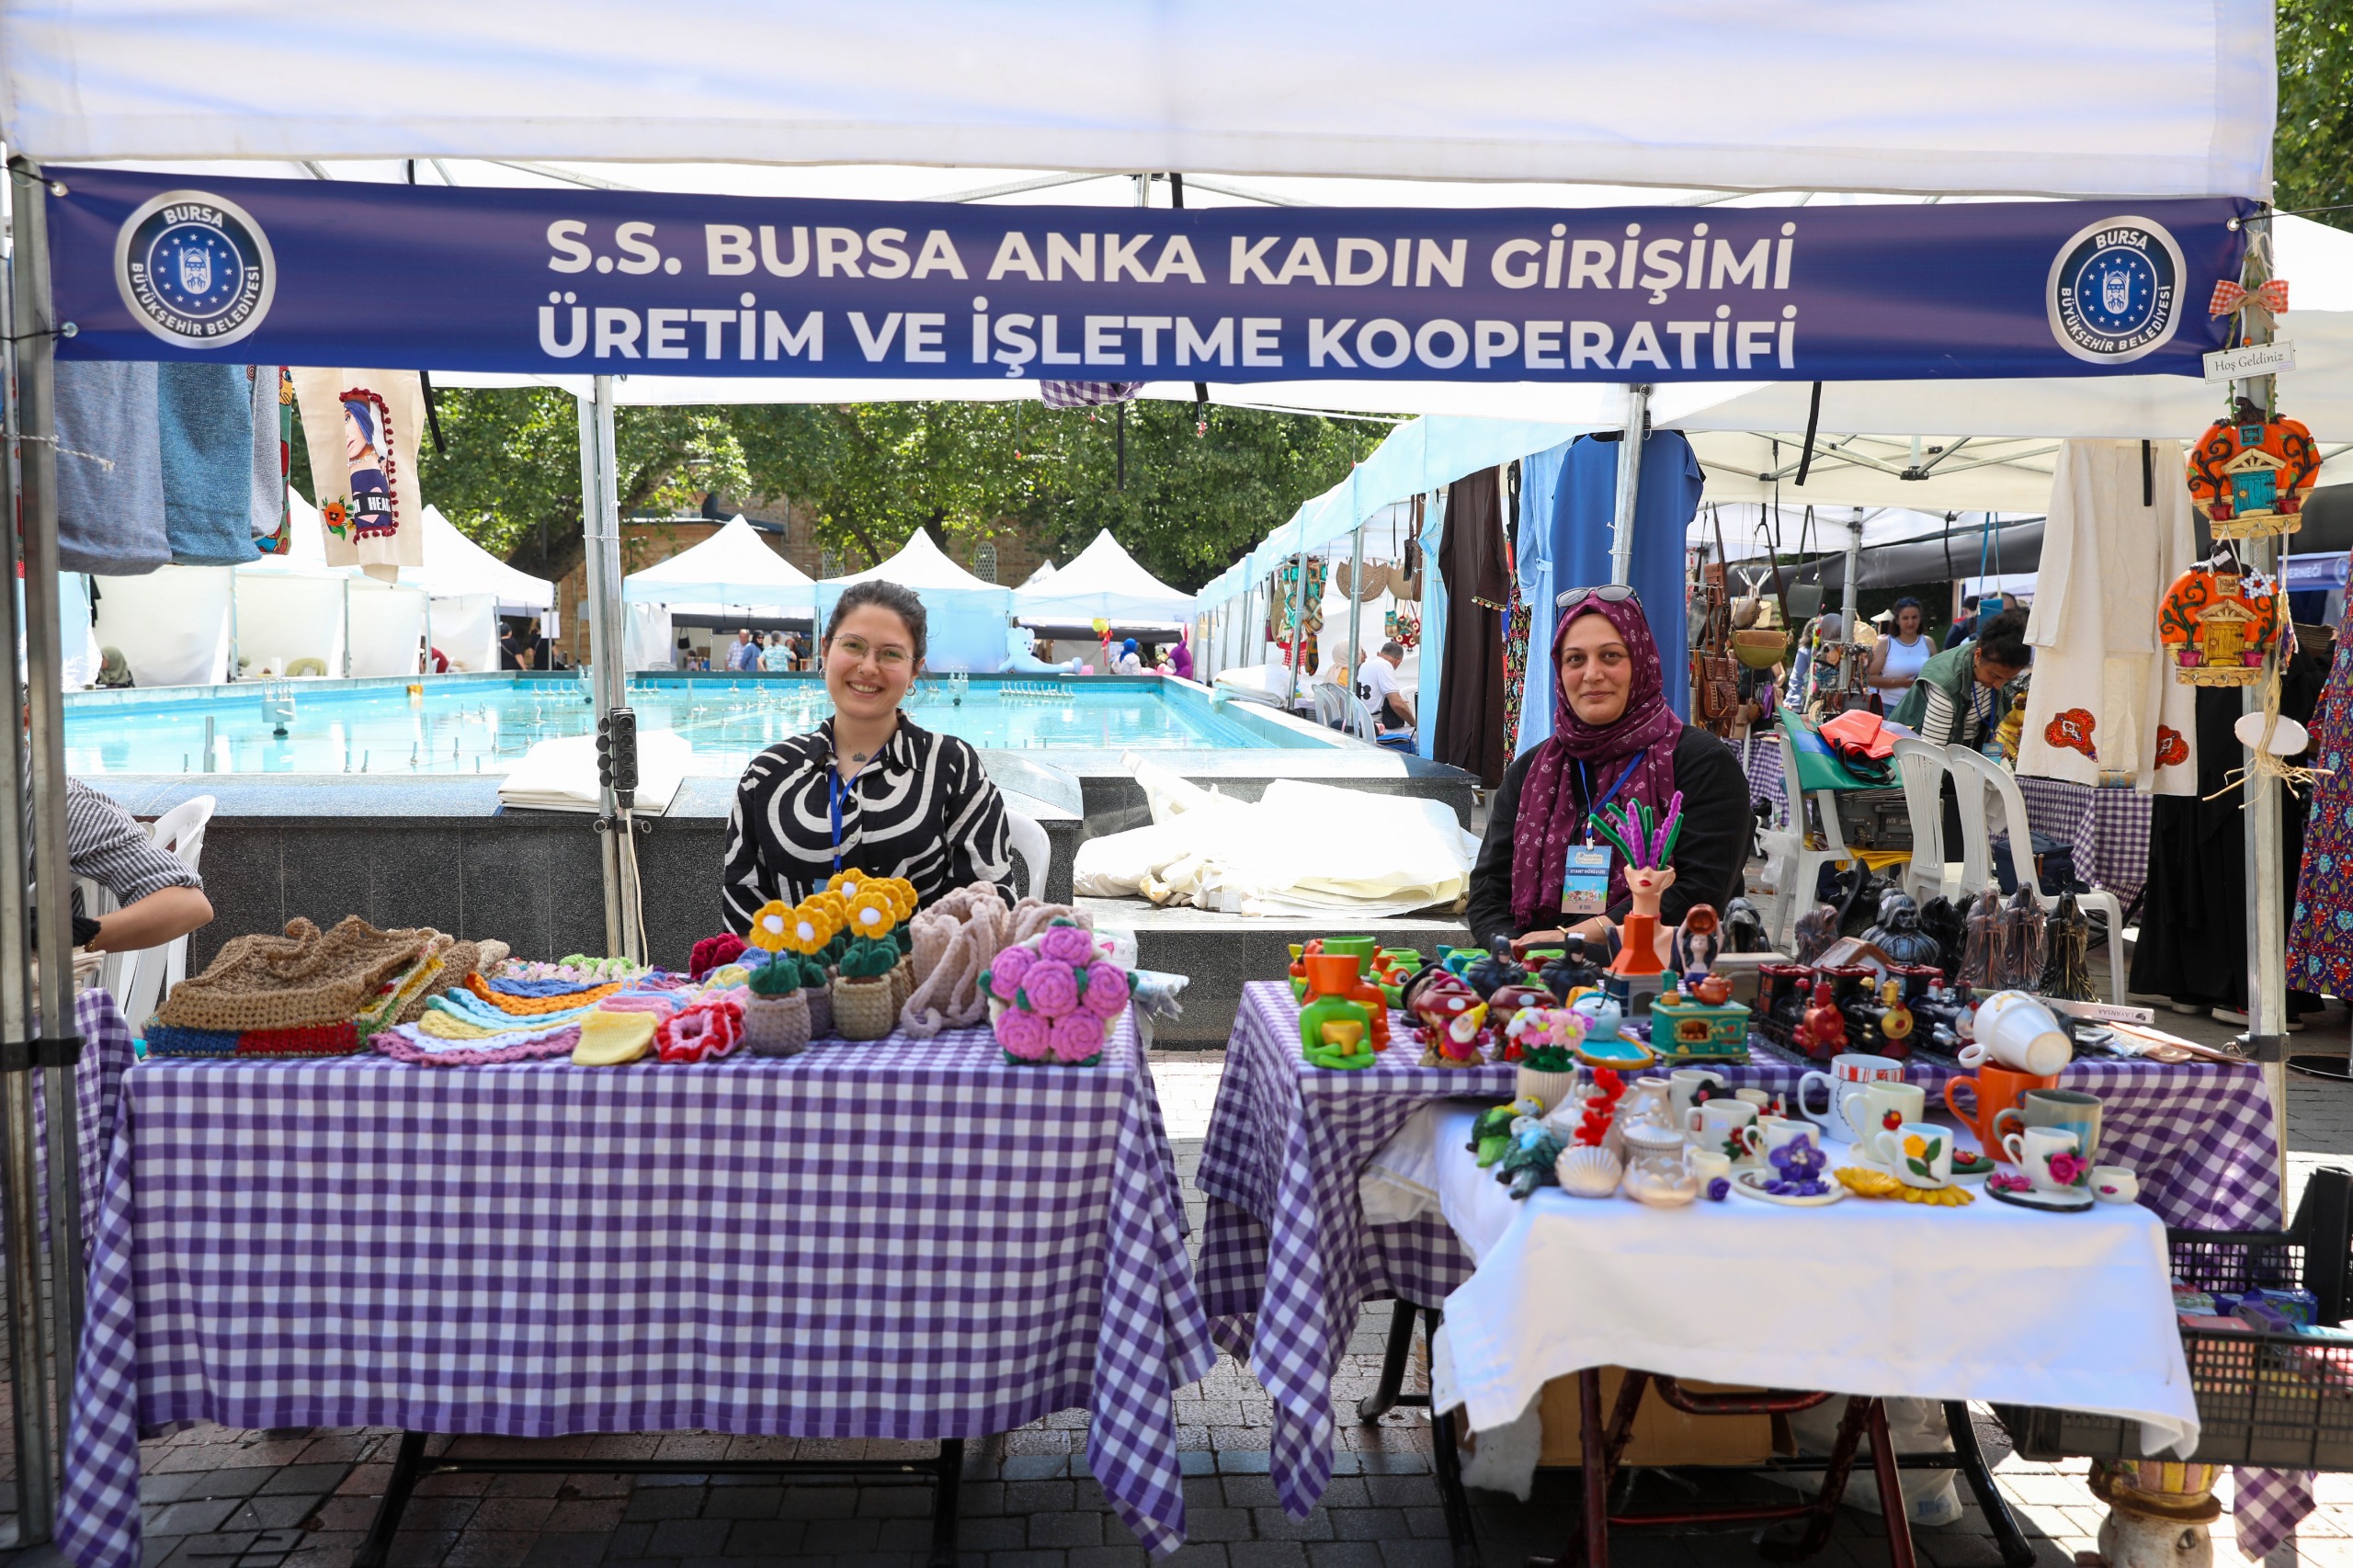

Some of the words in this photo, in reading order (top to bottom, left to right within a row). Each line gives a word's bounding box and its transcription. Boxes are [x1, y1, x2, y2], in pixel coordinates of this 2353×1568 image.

[164, 205, 223, 228] BURSA
[2095, 230, 2148, 251] BURSA
[547, 220, 682, 275] S.S.
[705, 223, 968, 279] BURSA
[986, 231, 1207, 283] ANKA
[1230, 235, 1468, 288] KADIN
[1491, 222, 1796, 305] GİRİŞİMİ
[131, 262, 202, 335] BÜYÜKŞEHİR
[207, 266, 259, 335] BELEDİYESİ
[2061, 287, 2114, 351] BÜYÜKŞEHİR
[2118, 285, 2172, 351] BELEDİYESİ
[538, 290, 824, 361] ÜRETİM
[847, 312, 947, 363] VE
[972, 296, 1283, 379] İŞLETME
[1308, 304, 1798, 369] KOOPERATİFİ
[2214, 359, 2236, 373] Hoş
[2238, 351, 2284, 368] Geldiniz
